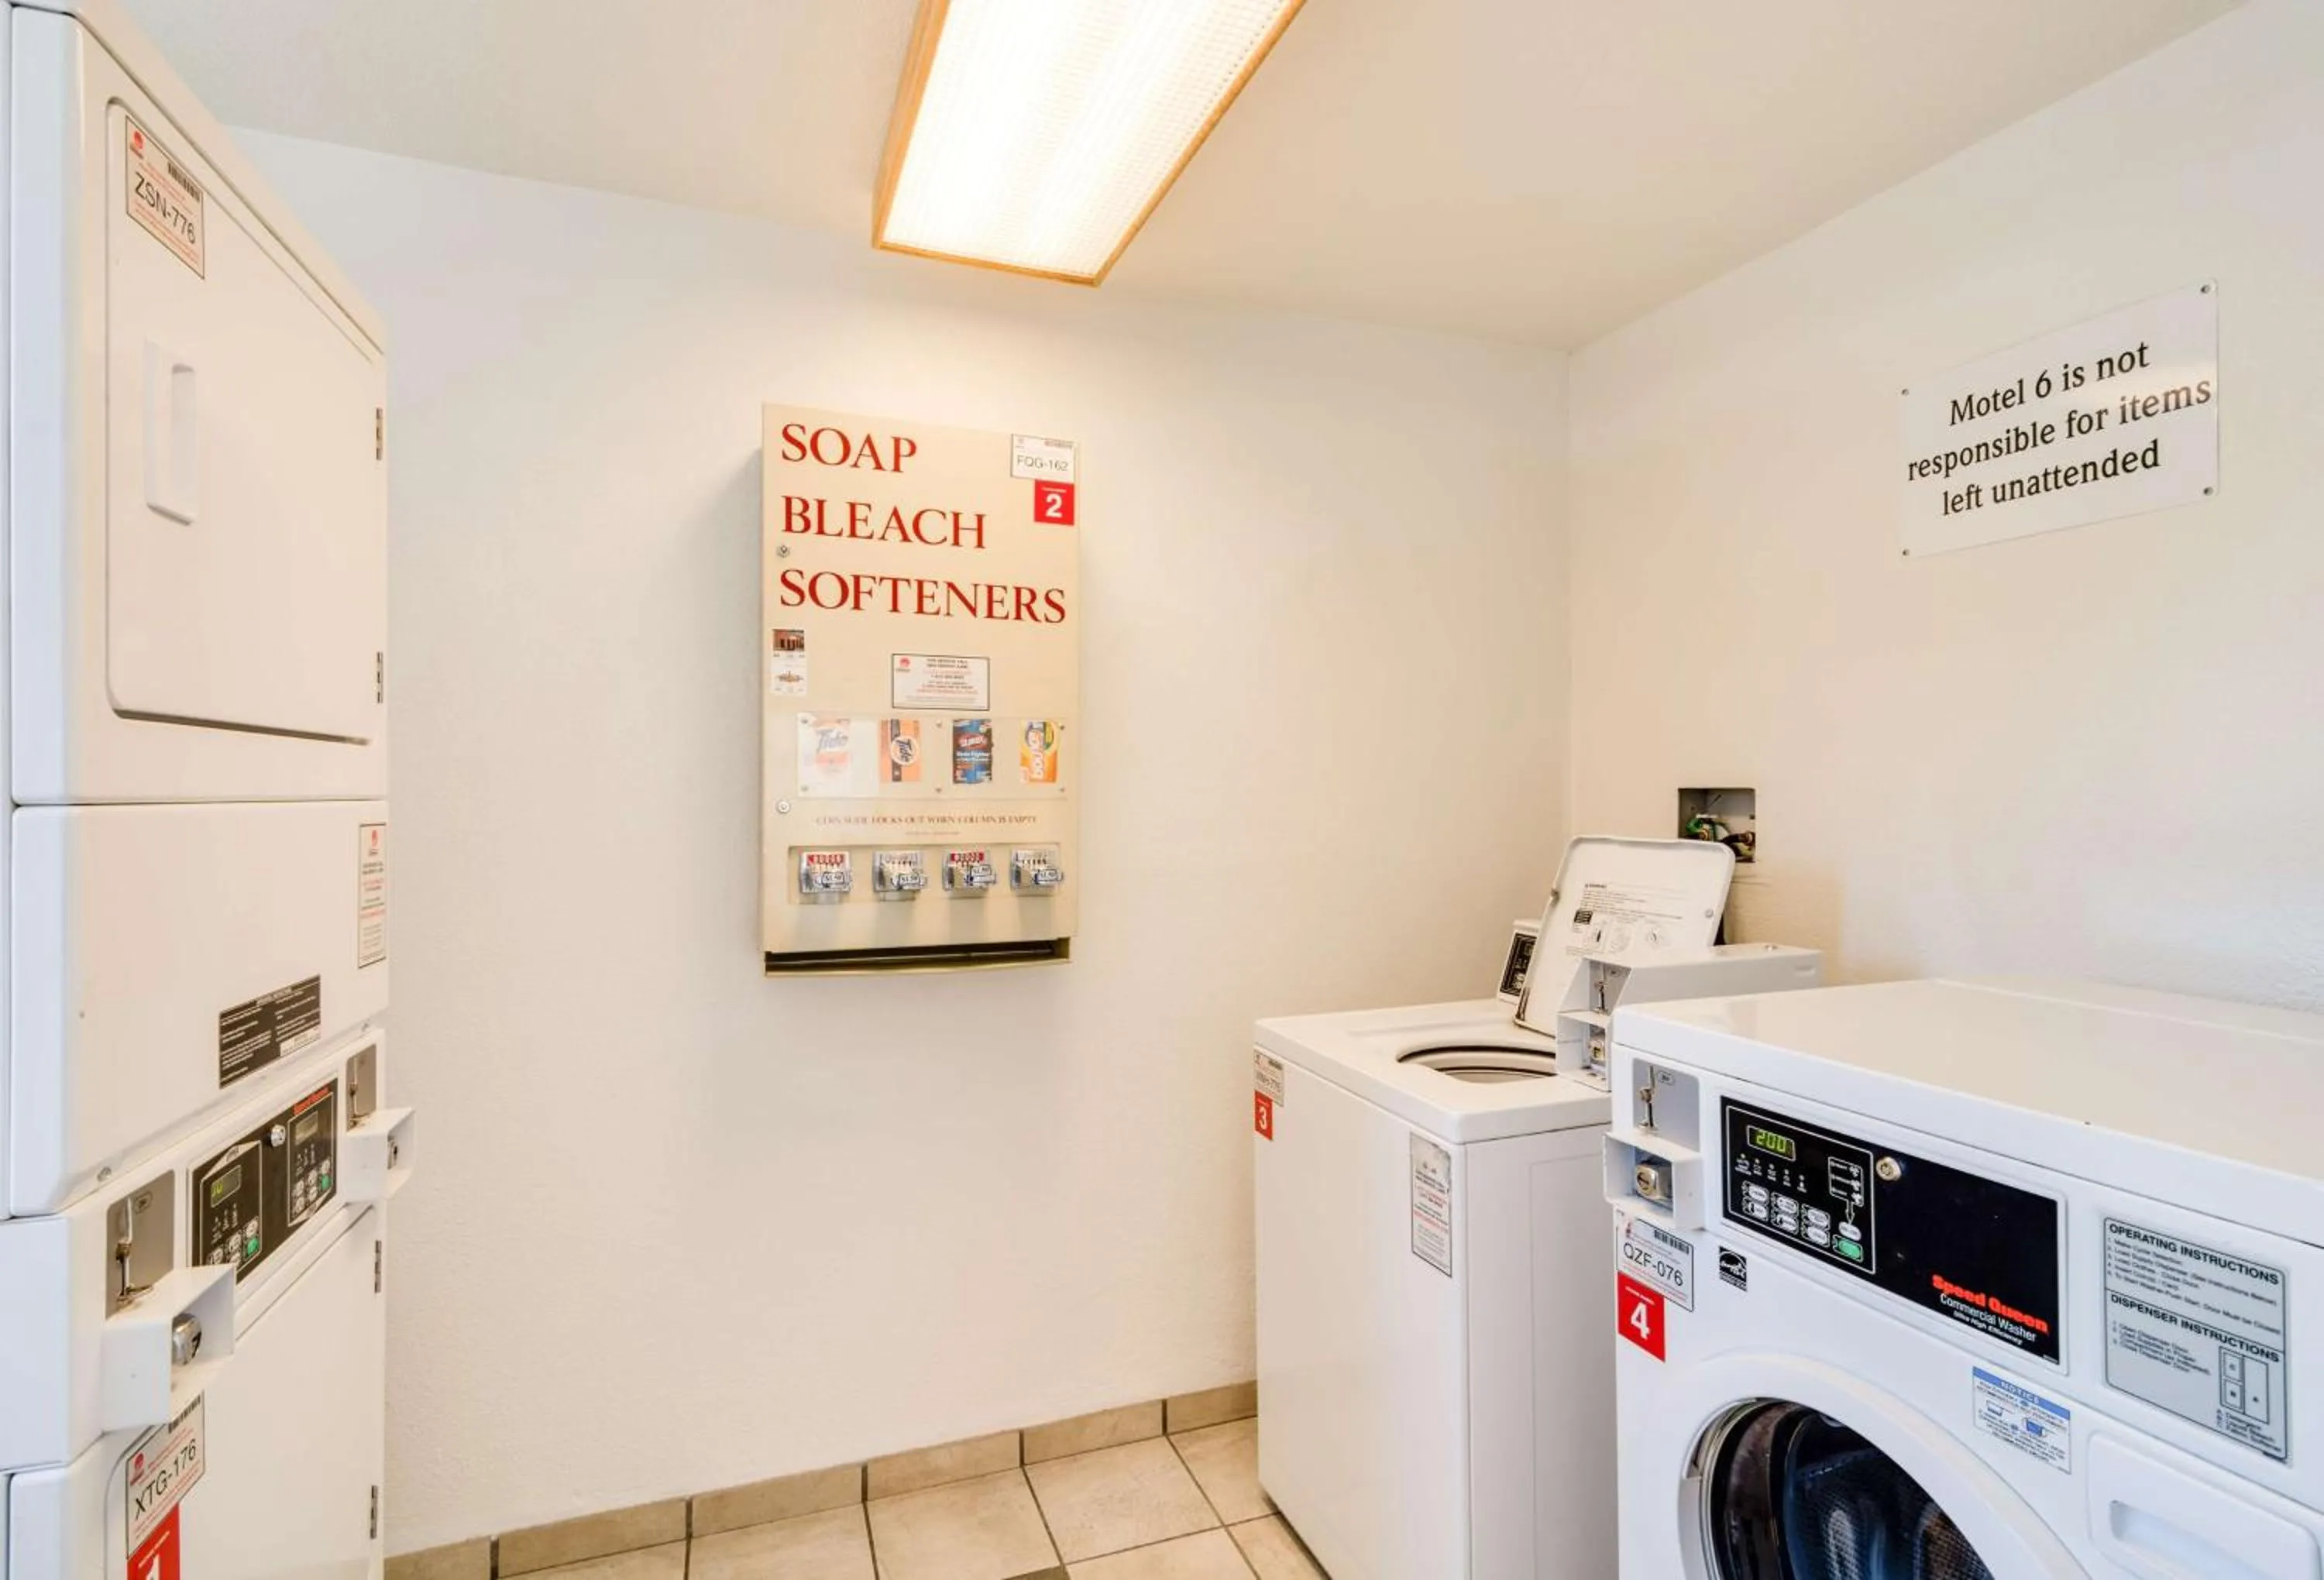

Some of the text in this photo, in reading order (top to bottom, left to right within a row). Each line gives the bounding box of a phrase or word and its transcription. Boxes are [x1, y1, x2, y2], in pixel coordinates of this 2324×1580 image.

[134, 170, 196, 245] ZSN-776
[1948, 341, 2150, 427] Motel 6 is not
[781, 423, 918, 474] SOAP
[1907, 379, 2212, 481] responsible for items
[1016, 454, 1069, 472] FQG-162
[1942, 438, 2161, 516] left unattended
[781, 495, 988, 550] BLEACH
[1044, 493, 1064, 519] 2
[779, 568, 1067, 624] SOFTENERS
[1259, 1105, 1268, 1130] 3
[1756, 1130, 1787, 1153] 200
[1623, 1242, 1684, 1287] QZF-076
[2109, 1223, 2280, 1286] OPERATING INSTRUCTIONS
[1630, 1301, 1650, 1340] 4
[1932, 1273, 2049, 1335] Speed Queen
[1940, 1292, 2037, 1342] Commercial Washer
[2110, 1293, 2178, 1325] DISPENSER
[2181, 1317, 2280, 1363] INSTRUCTIONS
[135, 1437, 197, 1520] XTG-176
